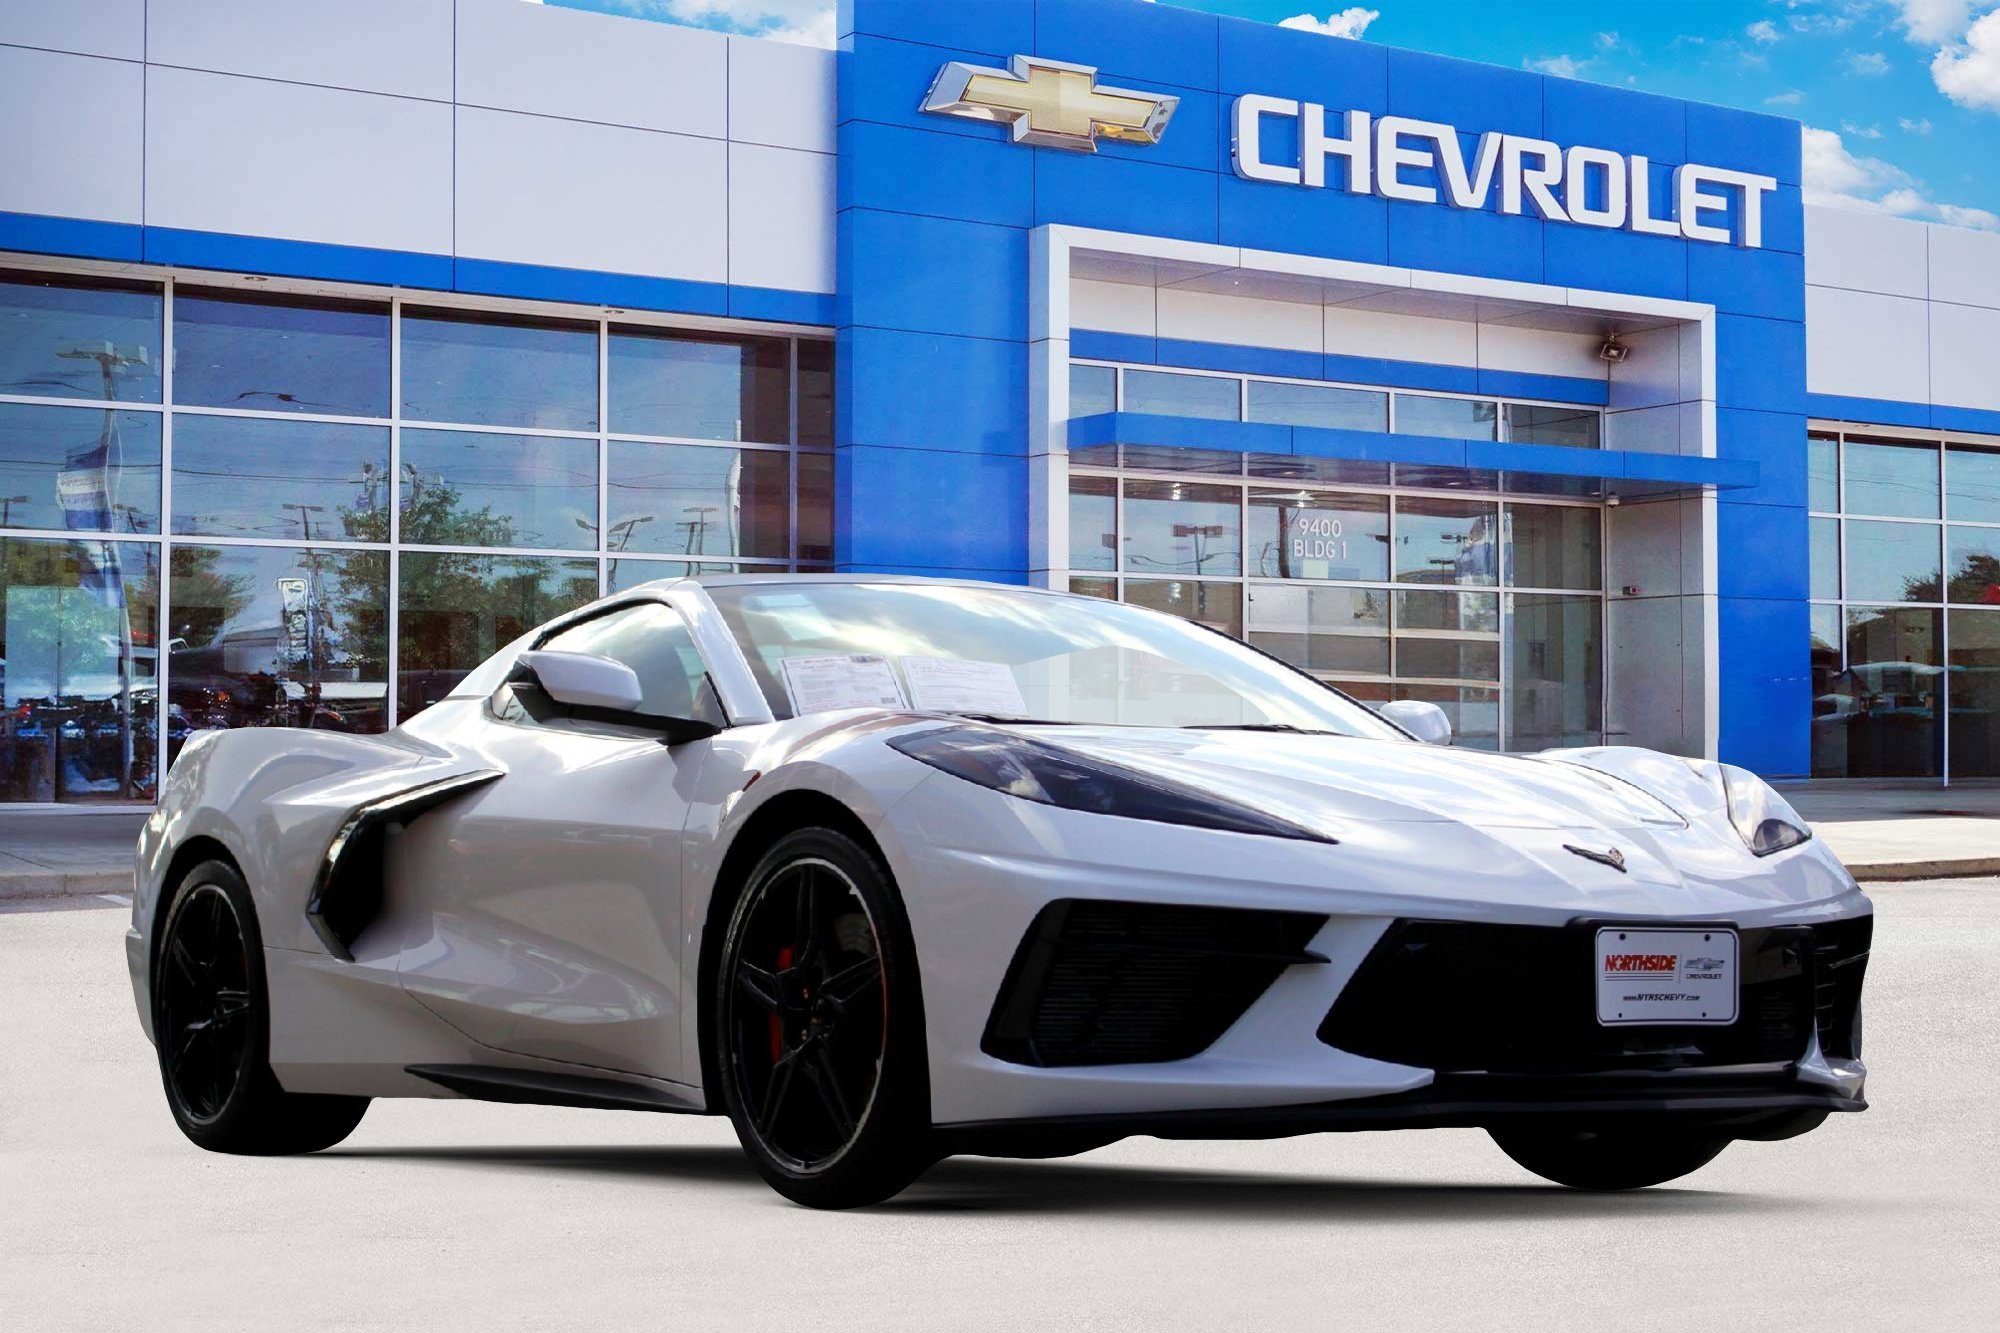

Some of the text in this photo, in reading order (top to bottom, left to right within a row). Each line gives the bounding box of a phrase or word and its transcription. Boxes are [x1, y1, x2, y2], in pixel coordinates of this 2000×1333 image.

[1231, 93, 1777, 248] CHEVROLET
[1299, 519, 1342, 537] 9400
[1294, 539, 1347, 559] BLDG 1
[1605, 954, 1677, 971] NORTHSIDE
